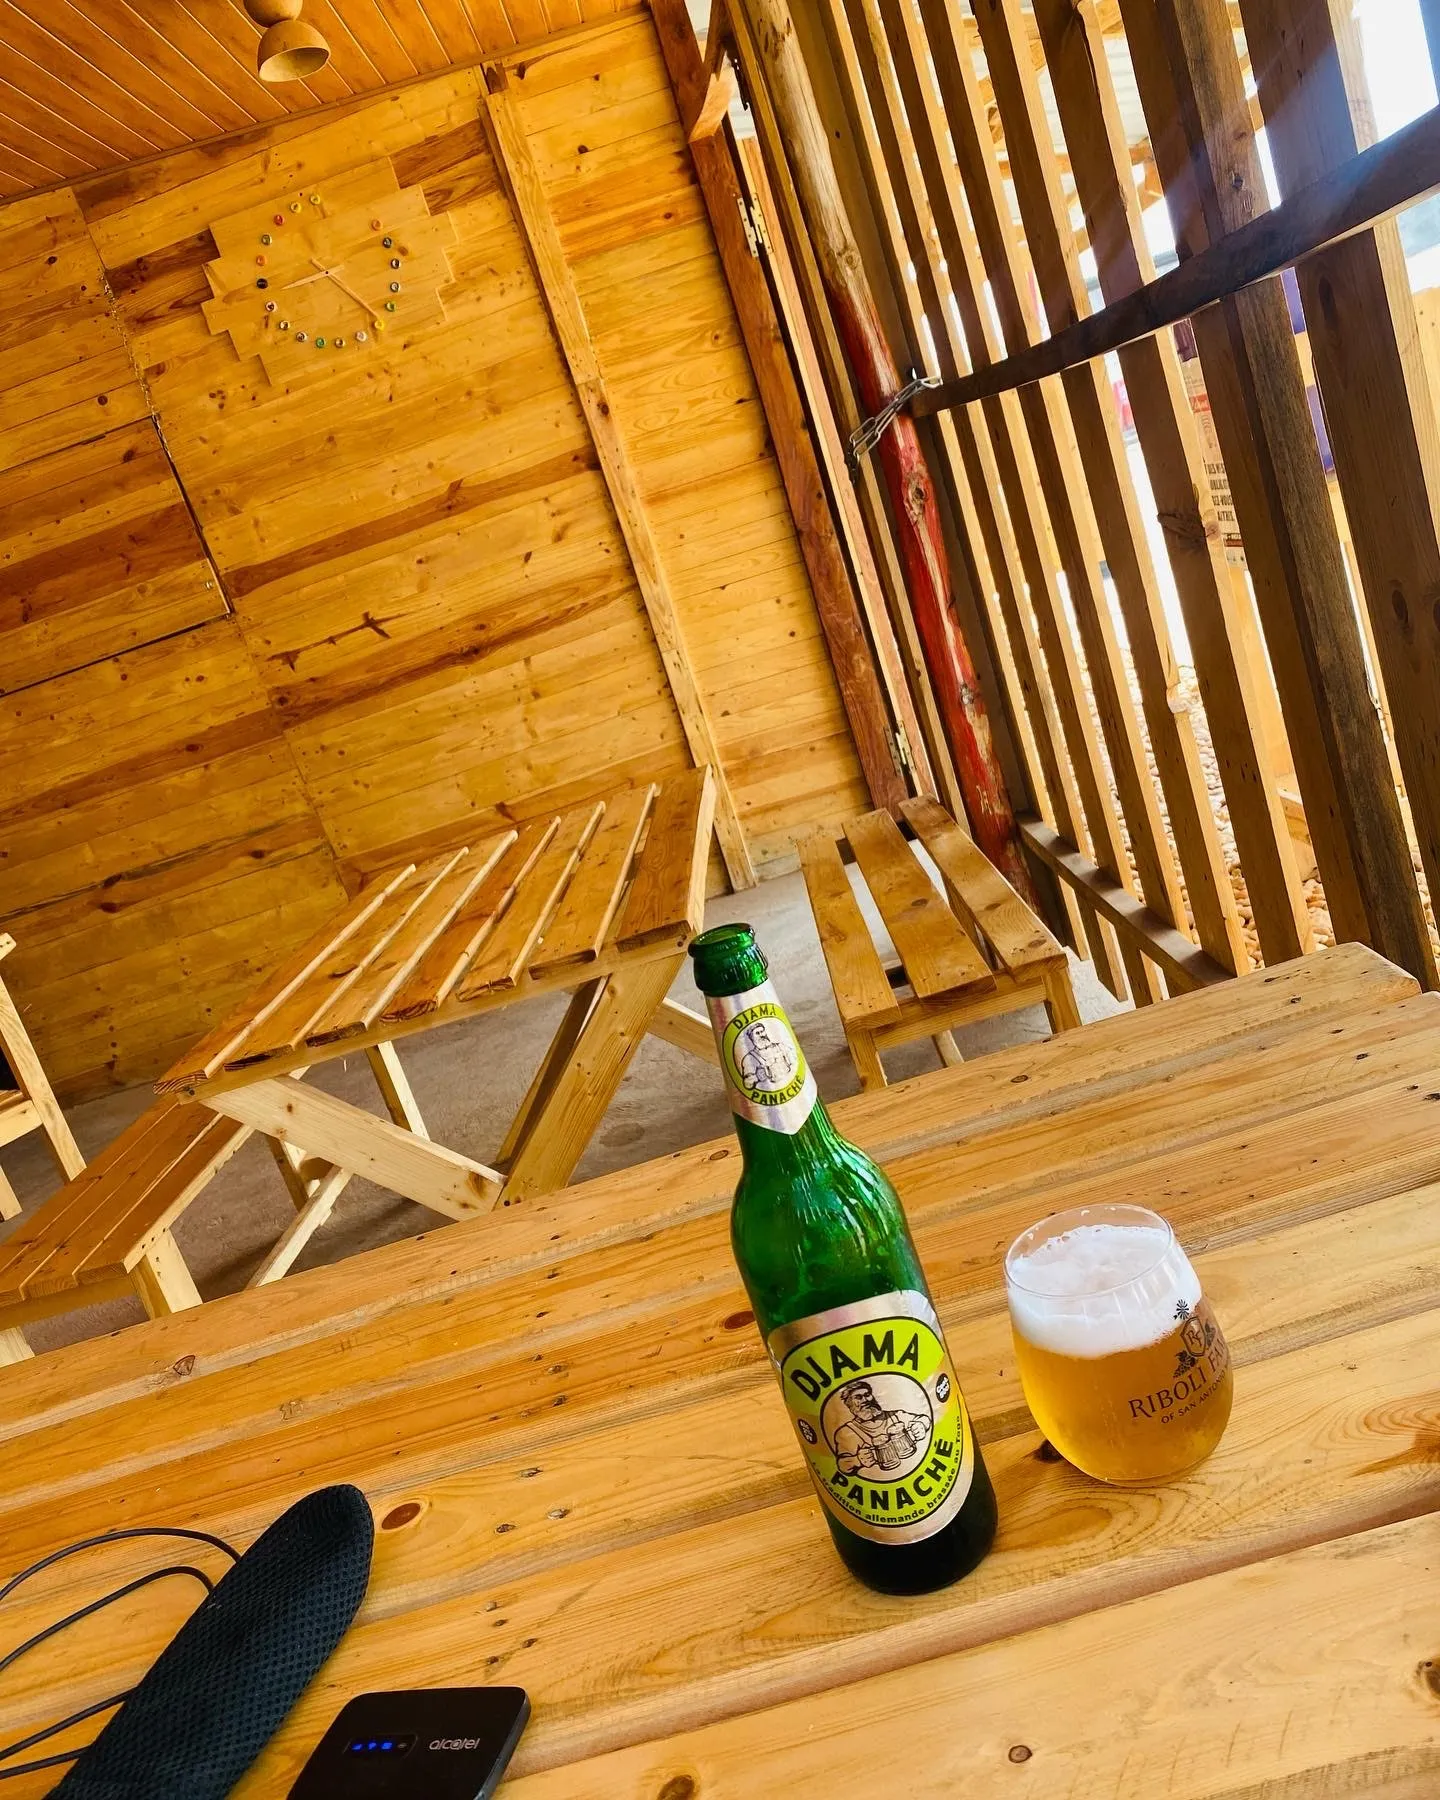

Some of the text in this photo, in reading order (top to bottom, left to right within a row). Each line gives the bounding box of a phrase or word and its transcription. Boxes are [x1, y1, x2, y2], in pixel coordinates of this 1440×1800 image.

[732, 1006, 777, 1030] DJAMA
[790, 1330, 919, 1402] DJAMA
[1128, 1366, 1207, 1418] RIBOLI
[1161, 1413, 1175, 1424] OF
[1178, 1401, 1197, 1417] SAN
[831, 1438, 953, 1511] PANACHÉ
[865, 1508, 925, 1524] allemande
[428, 1737, 480, 1751] alcatel
